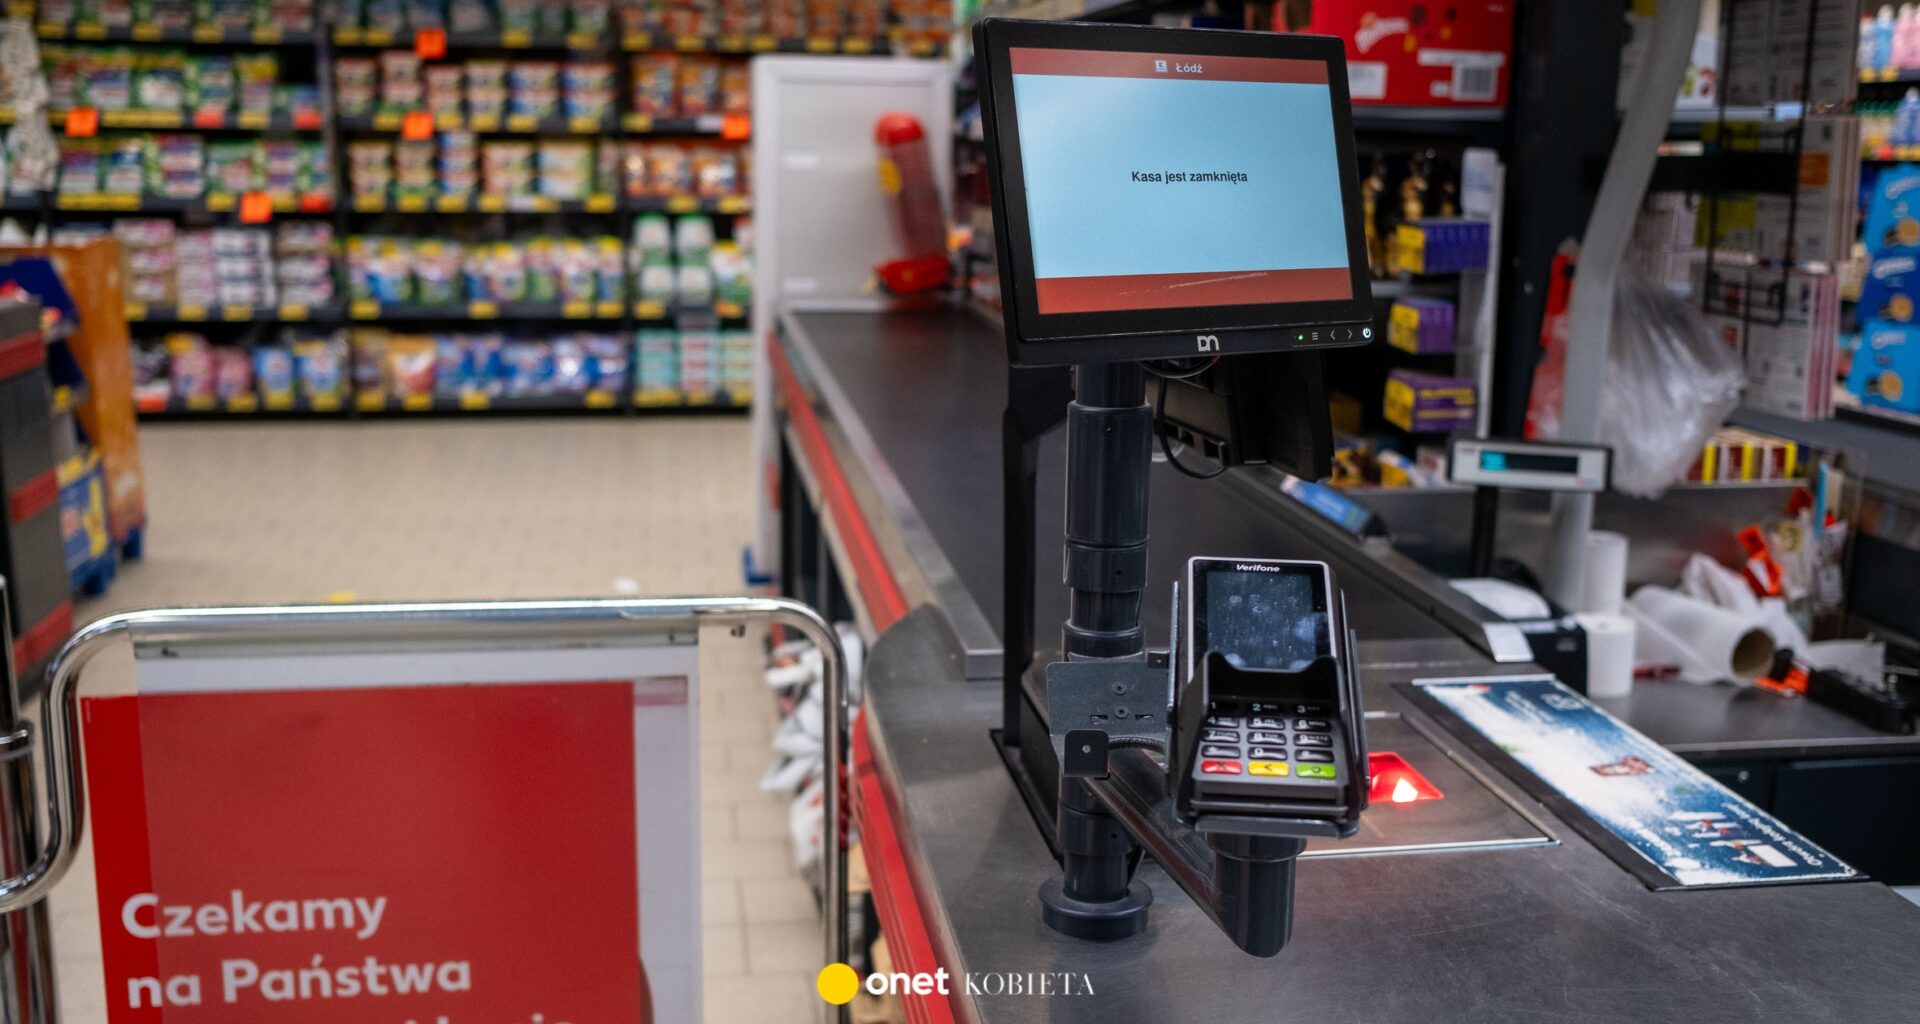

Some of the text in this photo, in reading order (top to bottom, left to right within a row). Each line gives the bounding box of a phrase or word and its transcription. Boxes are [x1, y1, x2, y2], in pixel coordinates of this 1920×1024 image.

[1175, 63, 1203, 73] Łódź
[1131, 171, 1248, 184] Kasa jest zamknięta
[1236, 564, 1280, 572] Verifone
[1252, 703, 1262, 711] 2
[1297, 705, 1306, 713] 3
[1254, 747, 1264, 757] 0
[121, 889, 387, 940] Czekamy
[127, 953, 471, 1008] na Państwa
